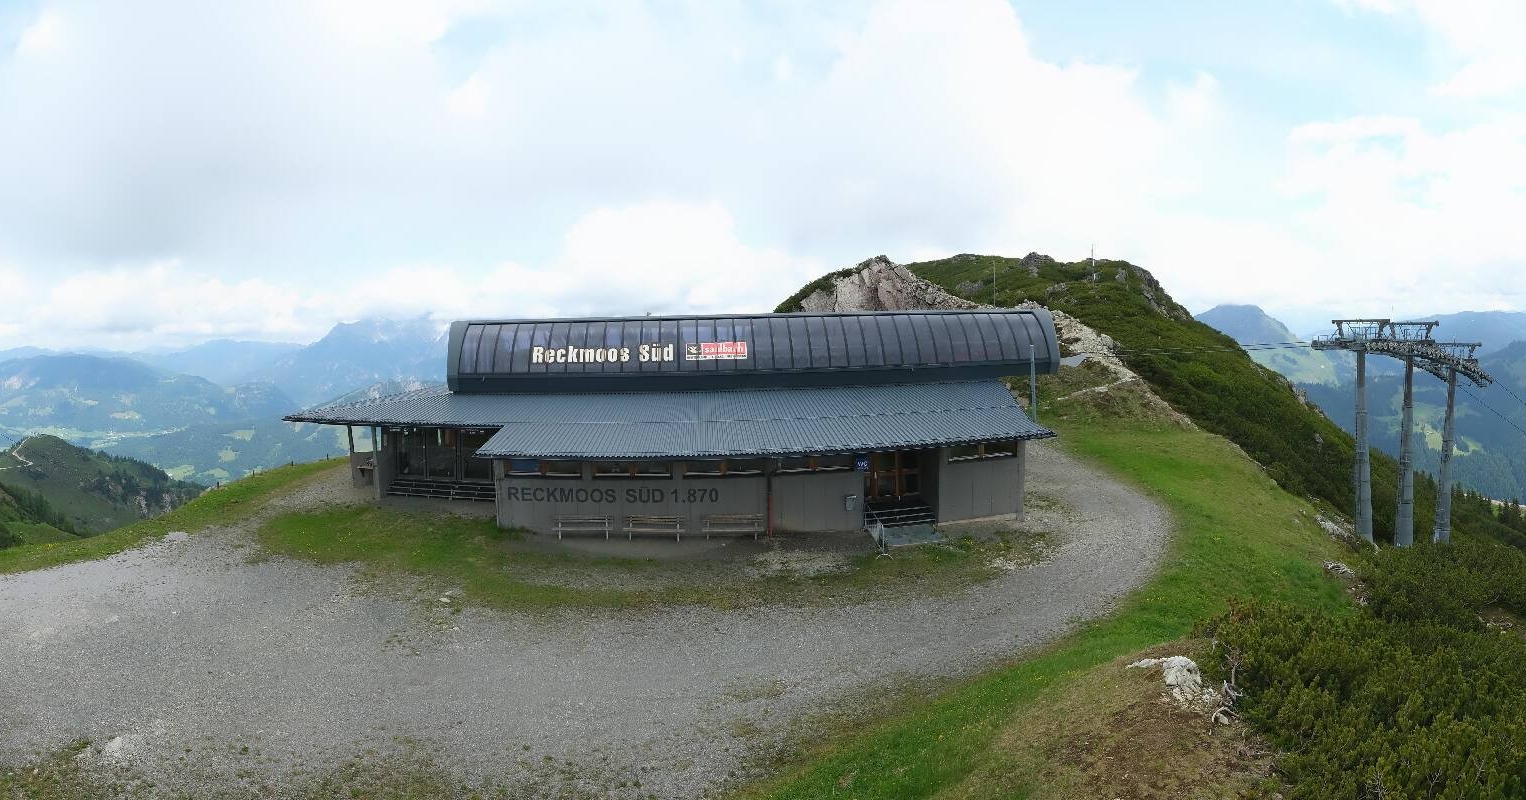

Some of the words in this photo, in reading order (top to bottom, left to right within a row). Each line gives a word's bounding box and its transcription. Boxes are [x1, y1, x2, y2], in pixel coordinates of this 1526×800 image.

[532, 345, 630, 363] Reckmoos
[639, 343, 674, 362] Süd
[507, 486, 617, 503] RECKMOOS
[625, 486, 665, 504] SÜD
[670, 488, 720, 504] 1.870
